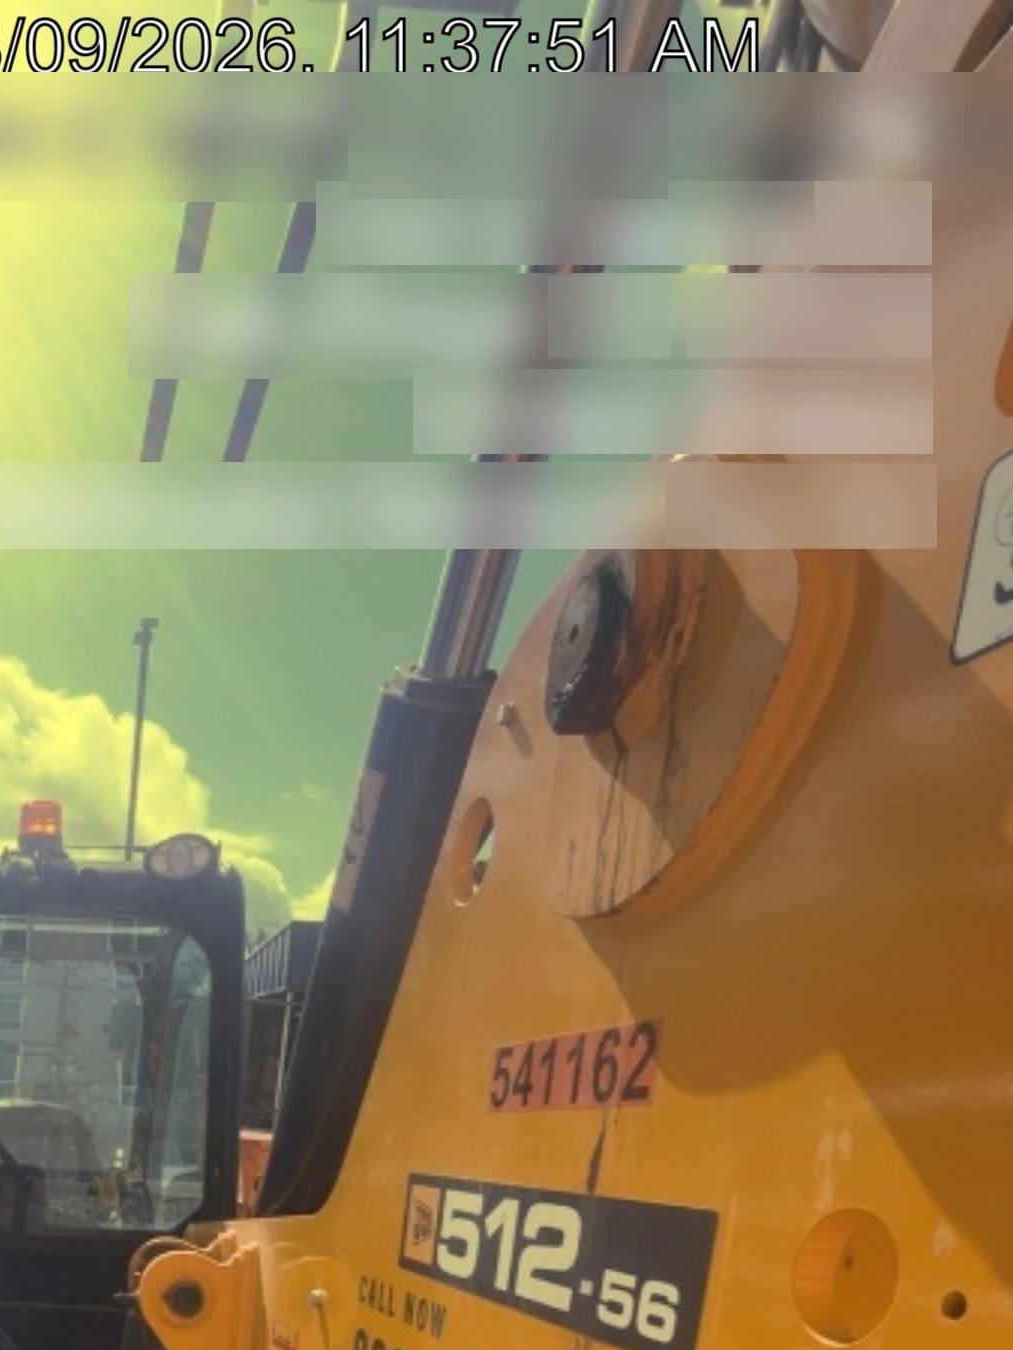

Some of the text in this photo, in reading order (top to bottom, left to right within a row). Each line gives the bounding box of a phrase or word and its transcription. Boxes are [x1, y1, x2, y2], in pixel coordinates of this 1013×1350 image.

[490, 1022, 659, 1108] 541162
[358, 1274, 447, 1340] CALL NOW
